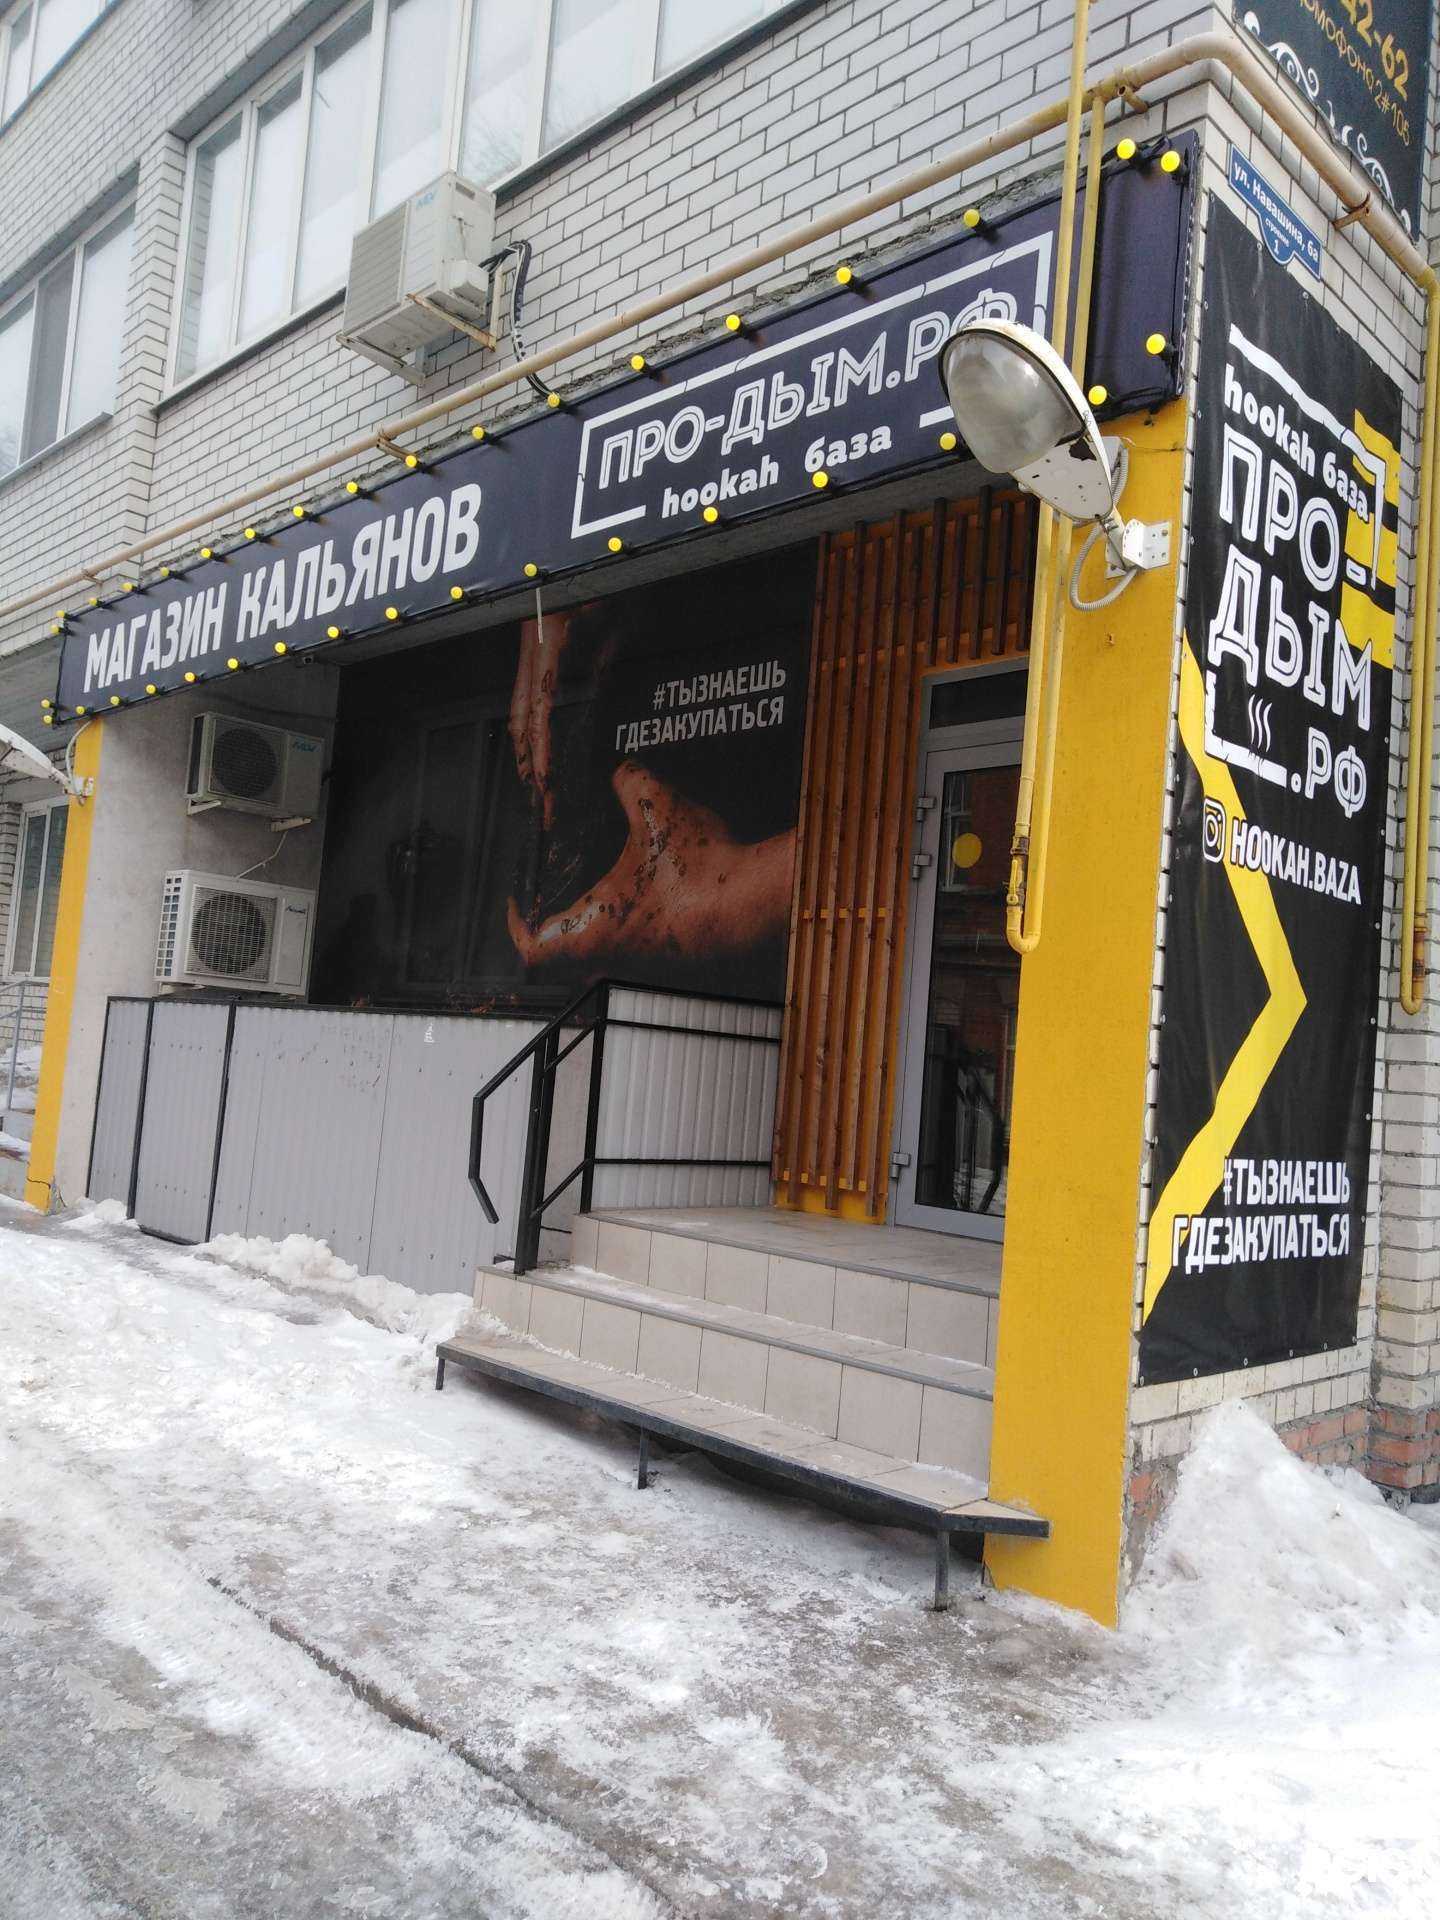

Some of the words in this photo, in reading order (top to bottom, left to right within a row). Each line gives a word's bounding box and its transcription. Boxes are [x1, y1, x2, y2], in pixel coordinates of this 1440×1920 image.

[1234, 162, 1250, 189] ул.
[1252, 178, 1306, 252] Навашина,
[1273, 239, 1280, 256] 1
[661, 455, 779, 518] hookah
[804, 425, 892, 473] база
[1224, 363, 1316, 477] hookah
[1322, 451, 1370, 523] база
[1219, 422, 1367, 592] ПРО-
[83, 582, 227, 693] МАГАЗИН
[236, 483, 482, 643] КАЛЬЯНОВ
[1207, 543, 1373, 731] ДЫМ
[615, 696, 785, 754] ГДЕЗАКУПАТЬСЯ
[653, 660, 786, 710] #ТЫЗНАЕШЬ
[1230, 818, 1361, 905] HOOKAH.BAZA
[1222, 1158, 1350, 1206] #ТЫЗНАЕШЬ
[1172, 1214, 1350, 1275] ГДЕЗАКУПАТЬСЯ
